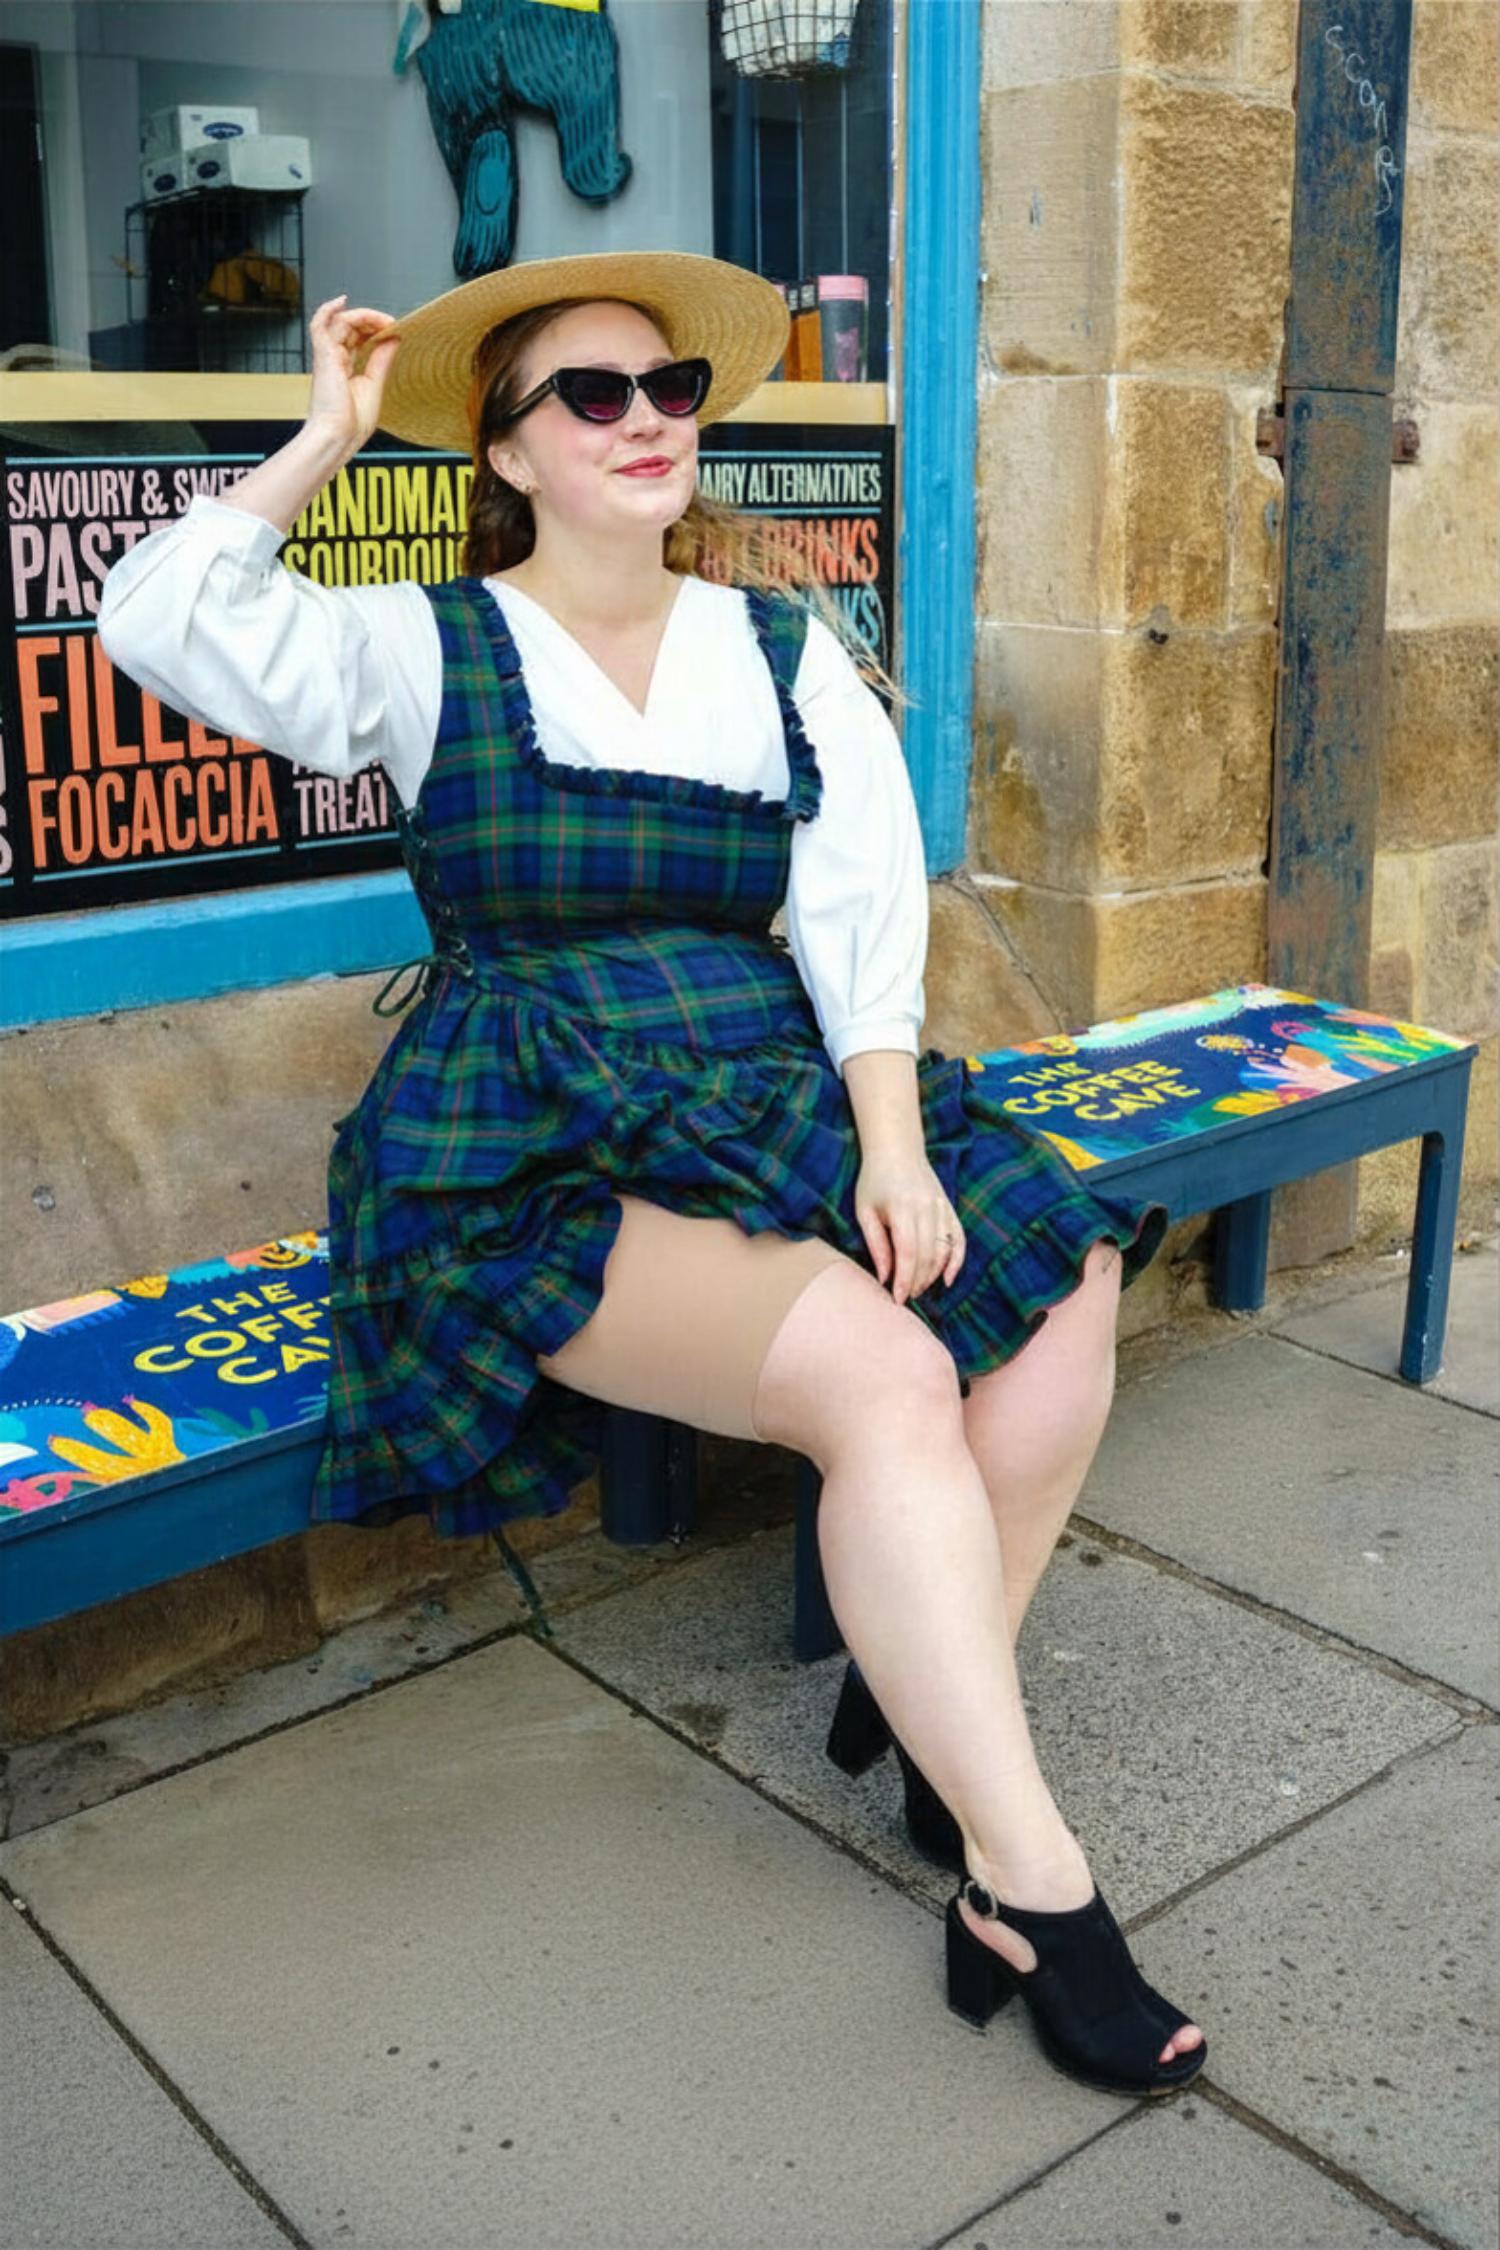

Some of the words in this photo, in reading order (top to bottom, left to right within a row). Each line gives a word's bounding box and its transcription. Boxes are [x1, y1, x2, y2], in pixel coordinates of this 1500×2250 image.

[7, 469, 135, 519] SAVOURY
[141, 468, 169, 515] &
[173, 467, 257, 513] SWE
[696, 463, 747, 503] AIRY
[17, 634, 265, 775] FILL
[27, 757, 279, 868] FOCACCIA
[1003, 1060, 1183, 1115] COFFEE
[1007, 1061, 1092, 1087] THE
[1074, 1080, 1201, 1121] CAVE
[175, 1281, 297, 1323] THE
[133, 1296, 330, 1373] COFF
